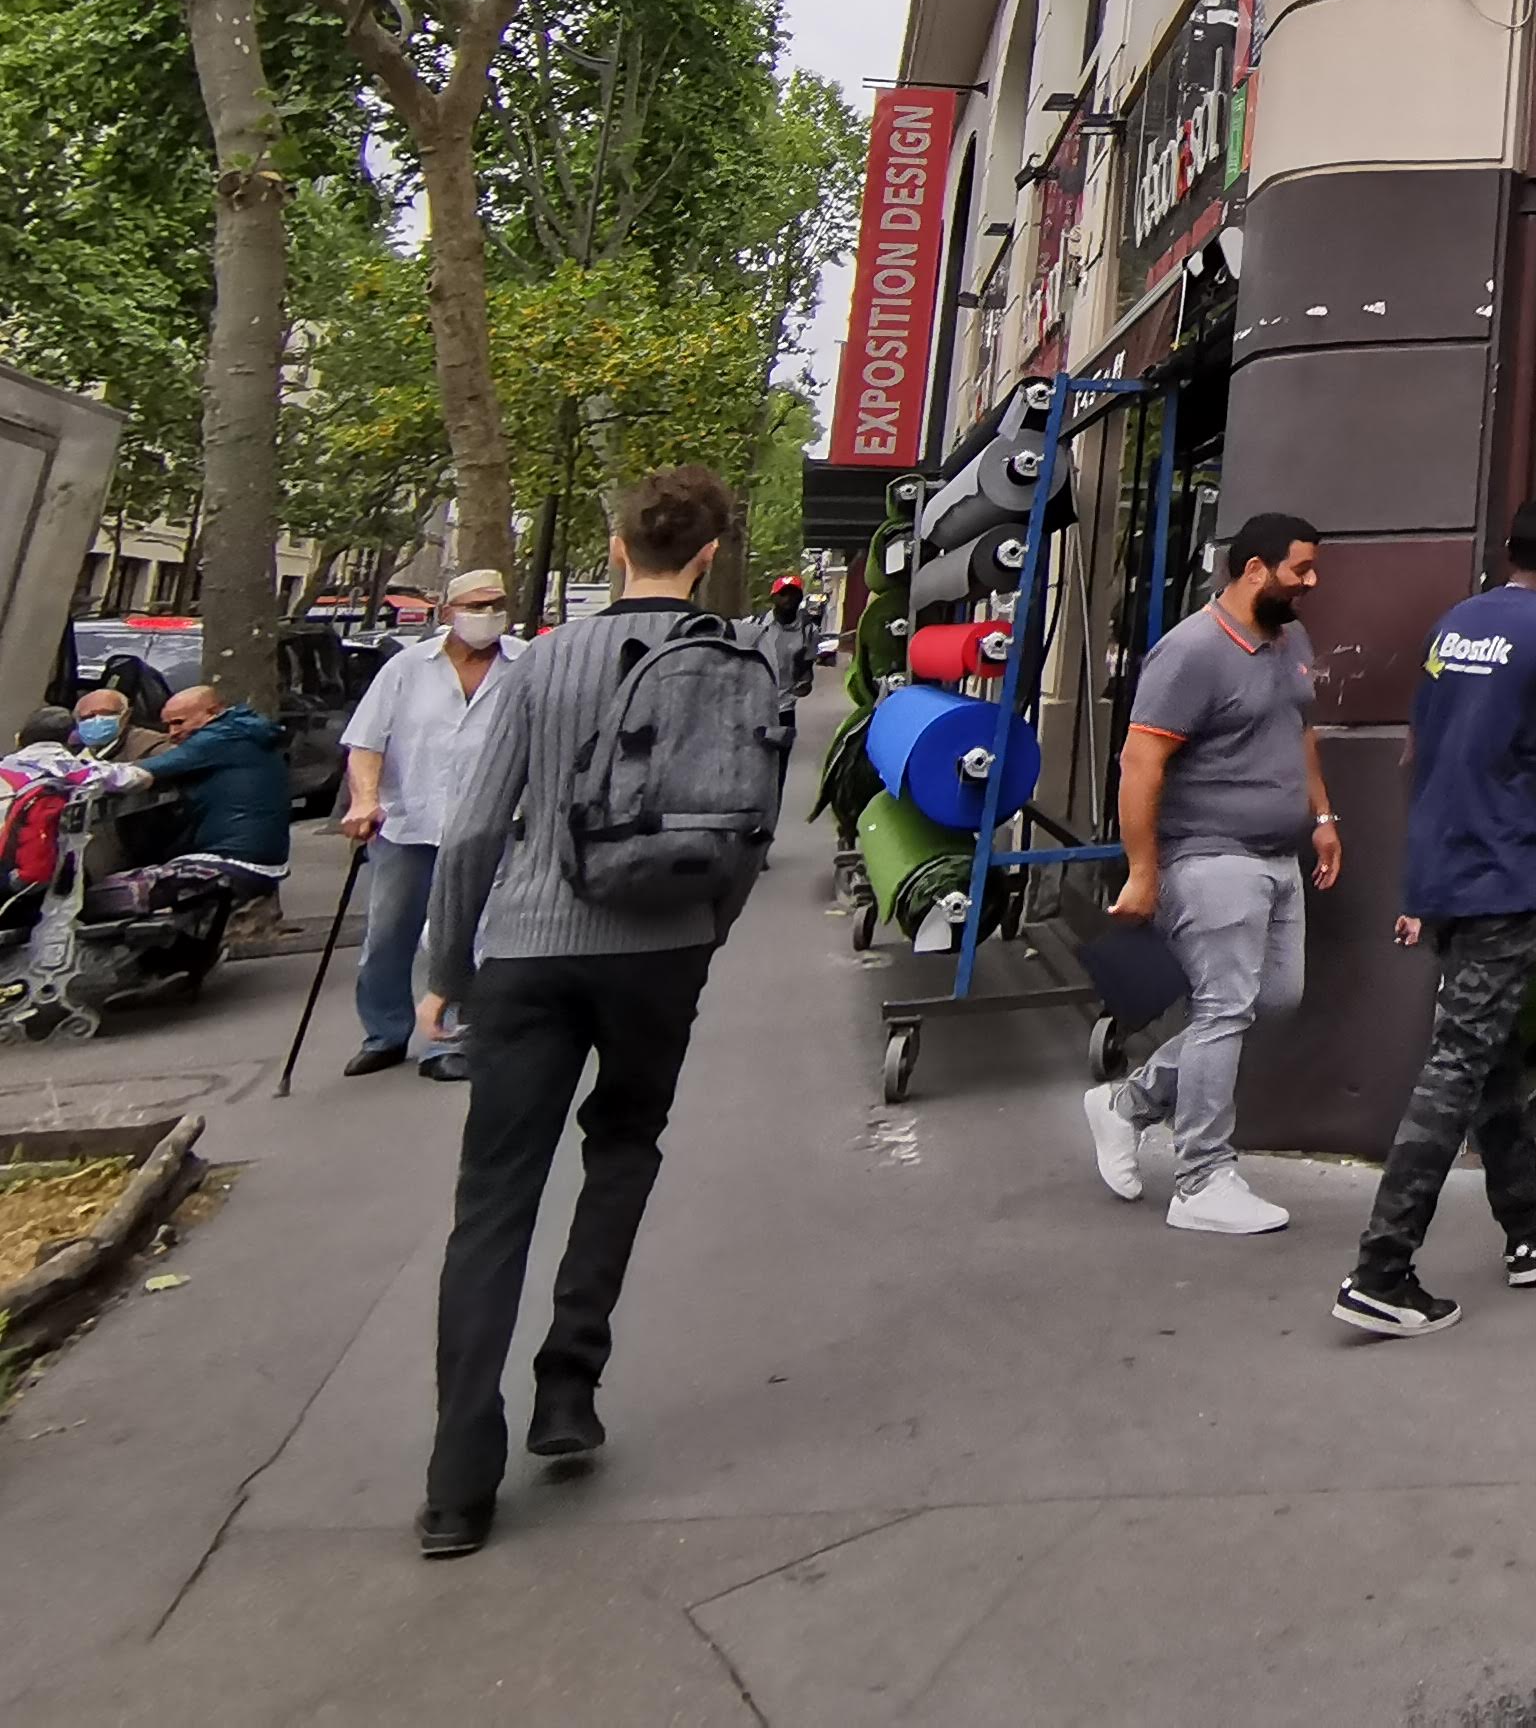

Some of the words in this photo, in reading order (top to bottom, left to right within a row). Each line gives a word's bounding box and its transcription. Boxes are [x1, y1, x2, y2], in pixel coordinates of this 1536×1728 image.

[880, 105, 933, 231] DESIGN
[854, 242, 918, 455] EXPOSITION
[1439, 632, 1513, 664] Bostik
